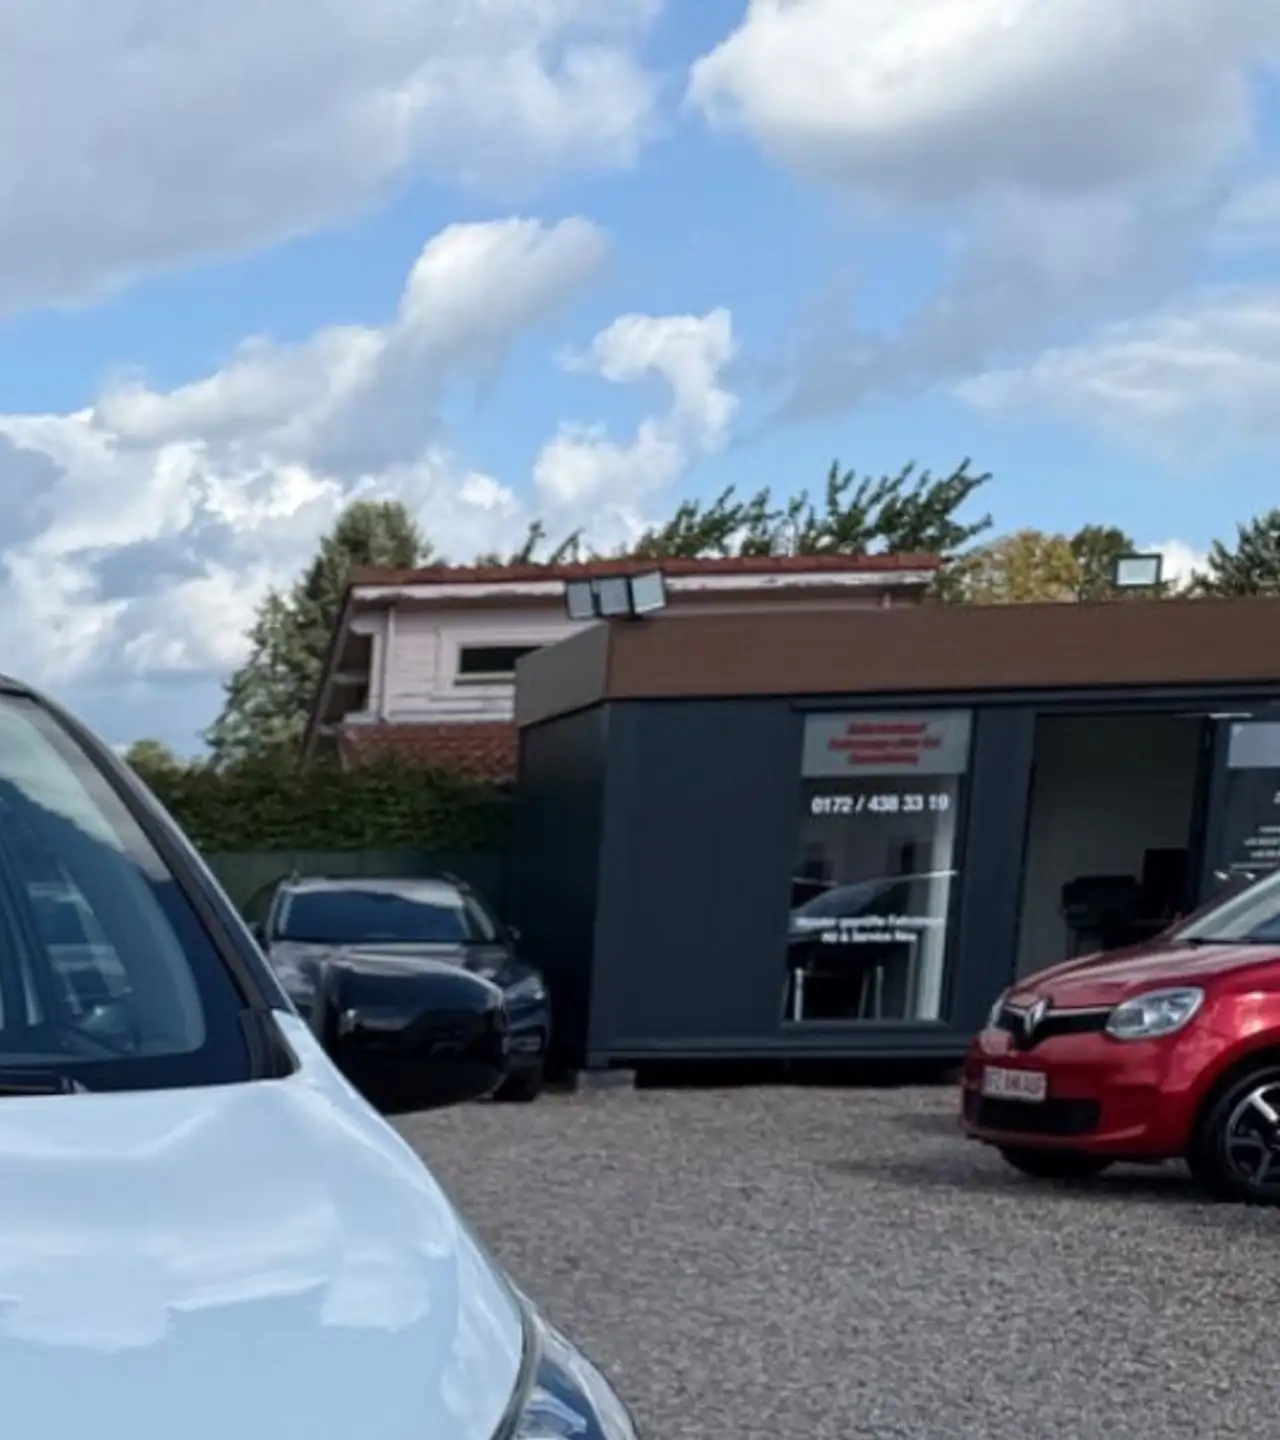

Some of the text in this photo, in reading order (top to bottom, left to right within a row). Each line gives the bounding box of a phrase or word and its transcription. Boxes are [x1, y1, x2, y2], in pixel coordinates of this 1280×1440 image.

[811, 796, 854, 814] 0172
[868, 794, 900, 812] 438
[903, 794, 924, 811] 33
